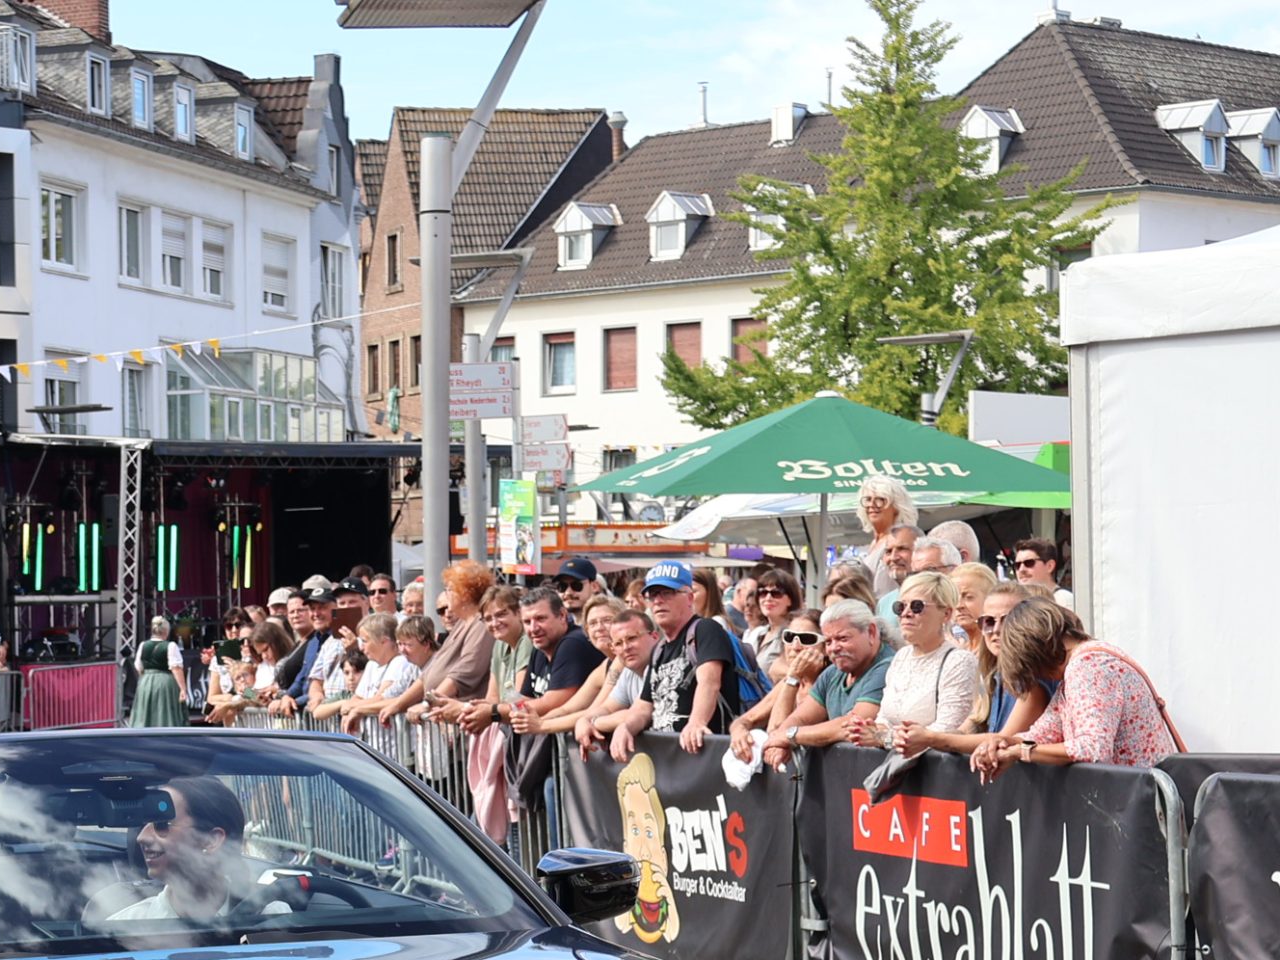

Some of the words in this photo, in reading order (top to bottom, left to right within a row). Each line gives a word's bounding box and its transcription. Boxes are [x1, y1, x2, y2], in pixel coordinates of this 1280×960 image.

[777, 459, 970, 482] Bolten
[665, 794, 748, 878] BEN'S
[858, 803, 961, 853] CAFE
[672, 871, 698, 898] Burger
[699, 876, 706, 895] &
[706, 877, 747, 903] Cocktailbar
